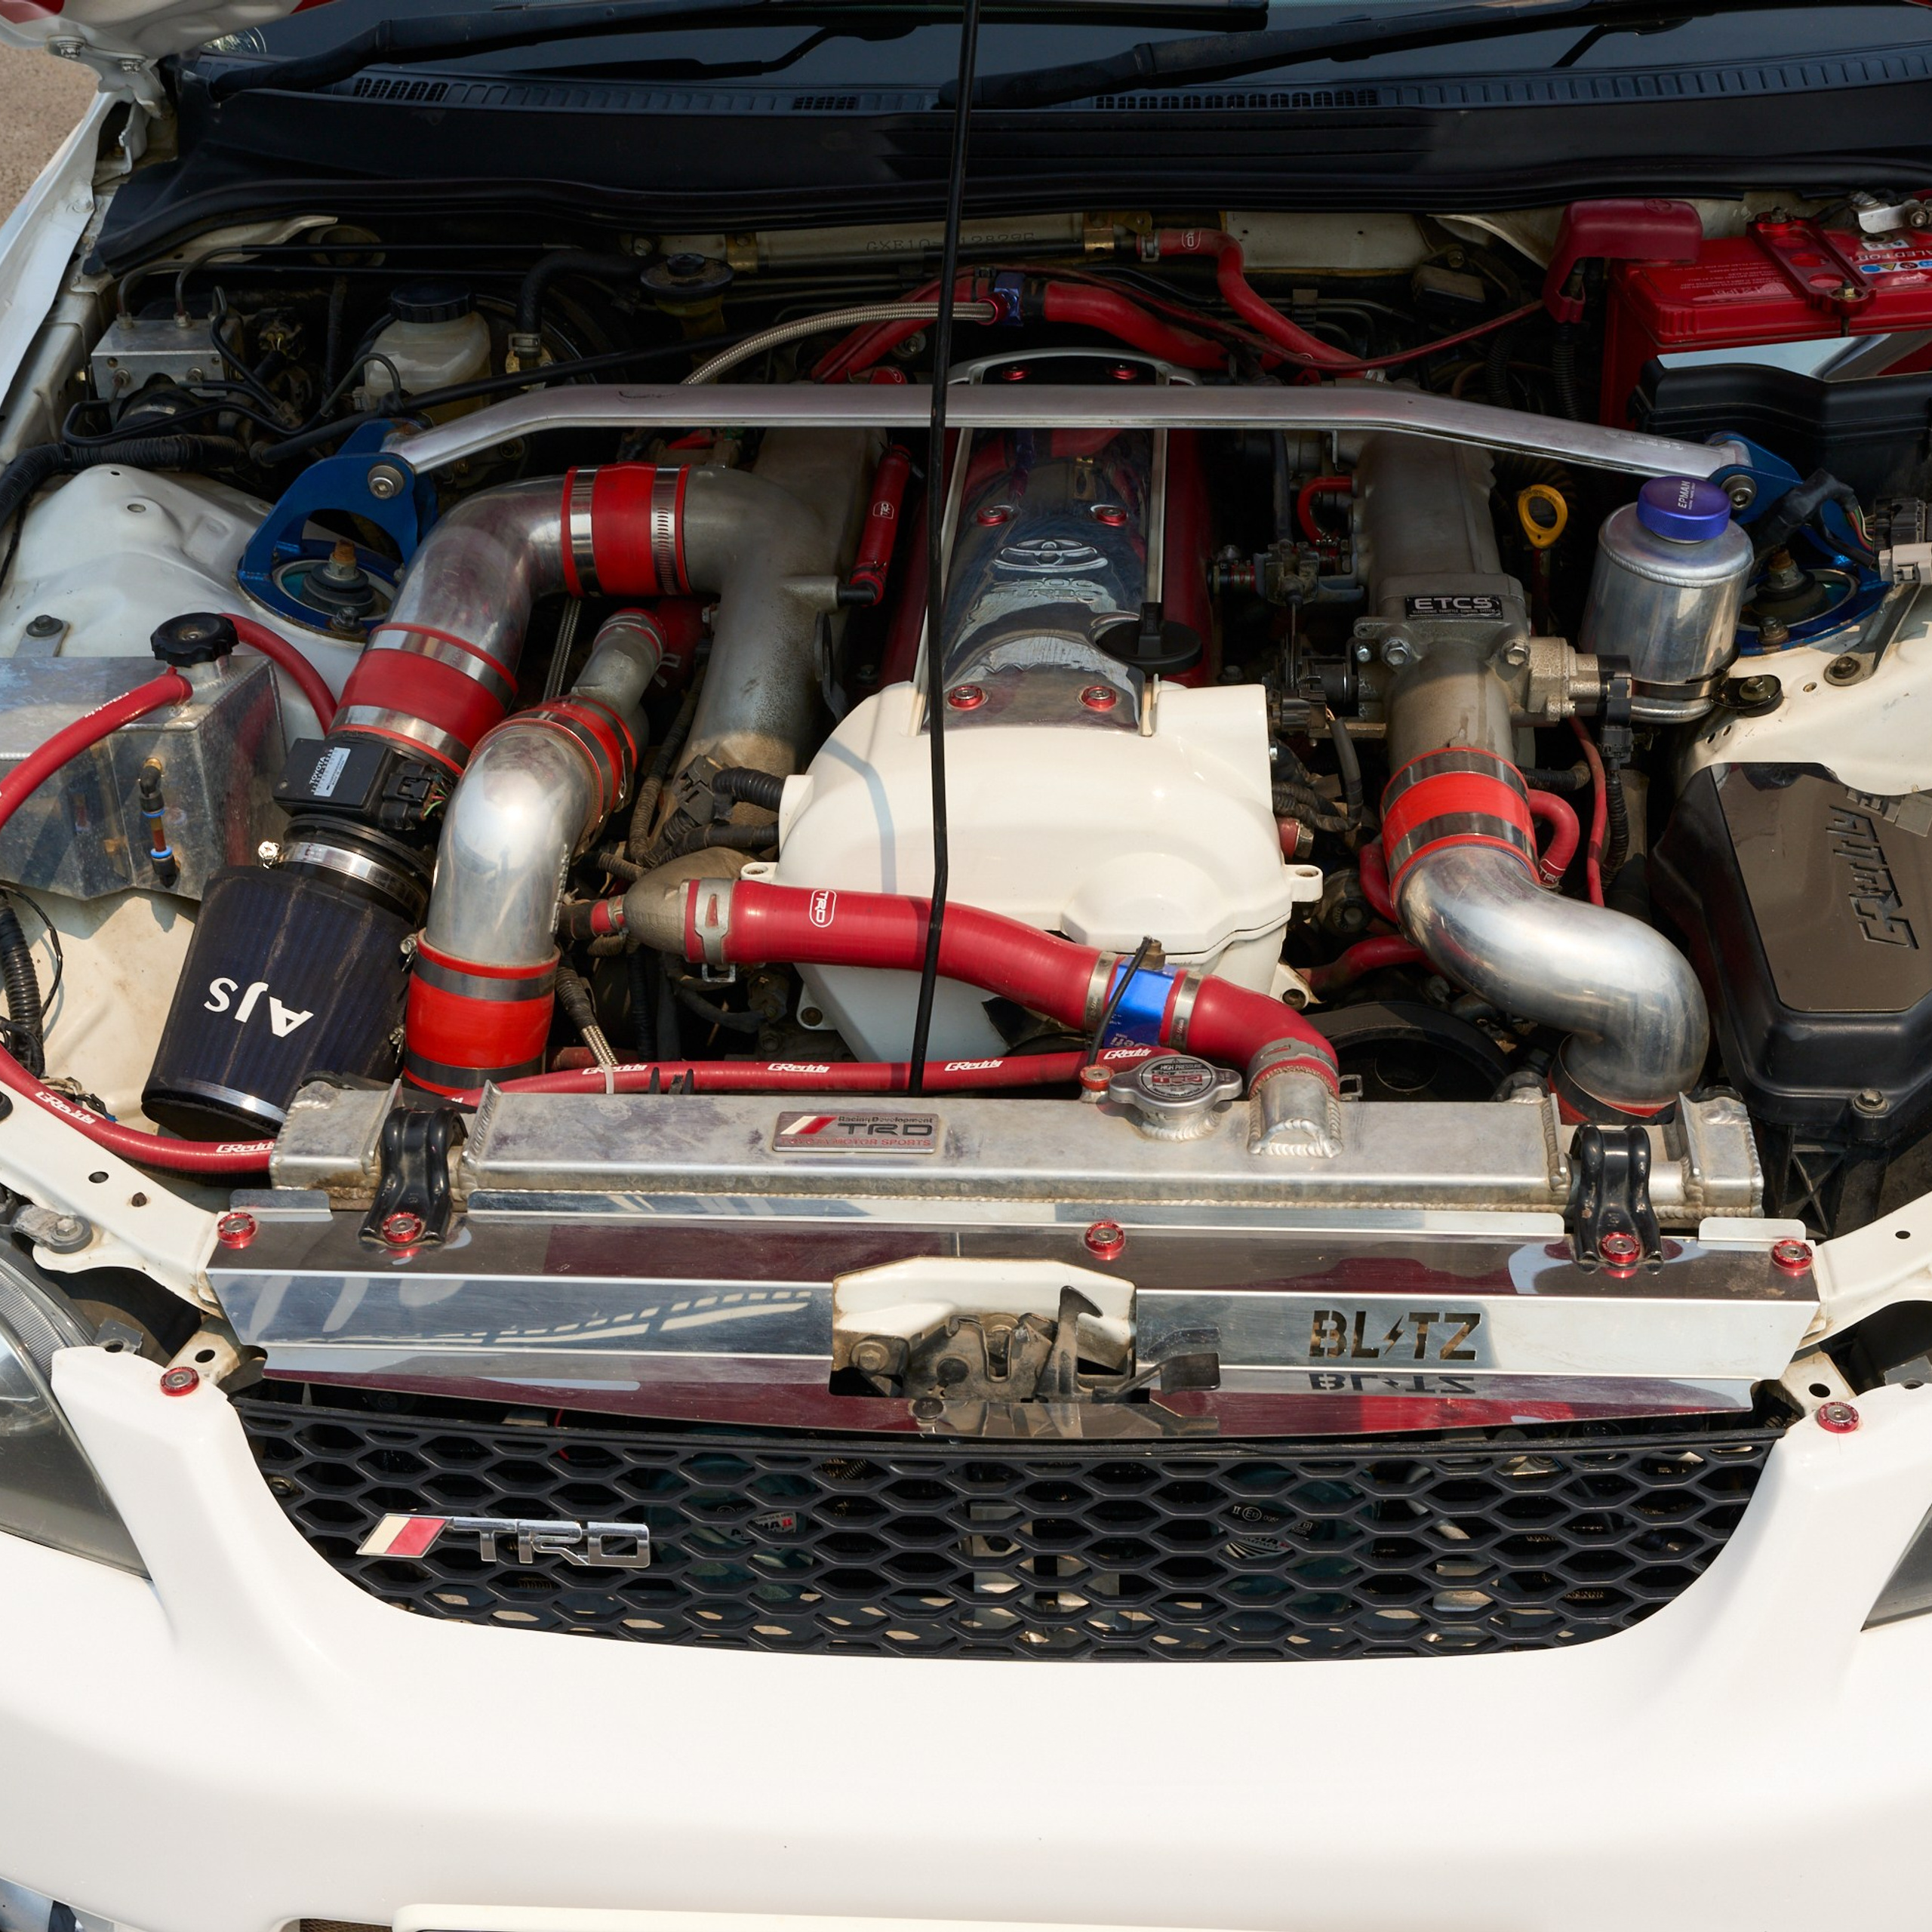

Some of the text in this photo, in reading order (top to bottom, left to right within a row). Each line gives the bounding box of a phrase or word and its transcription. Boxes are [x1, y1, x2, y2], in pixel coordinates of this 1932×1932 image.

[1678, 481, 1690, 509] EPMAN
[1414, 597, 1493, 610] ETCS
[309, 756, 326, 785] TOYOTA
[814, 891, 829, 923] TRD
[204, 977, 314, 1038] AJS
[768, 1063, 830, 1073] GReddy
[944, 1060, 1004, 1072] GReddy
[837, 1123, 933, 1137] TRD
[781, 1137, 932, 1146] TOYOTA MOTOR SPORTS
[453, 1515, 651, 1569] TRD
